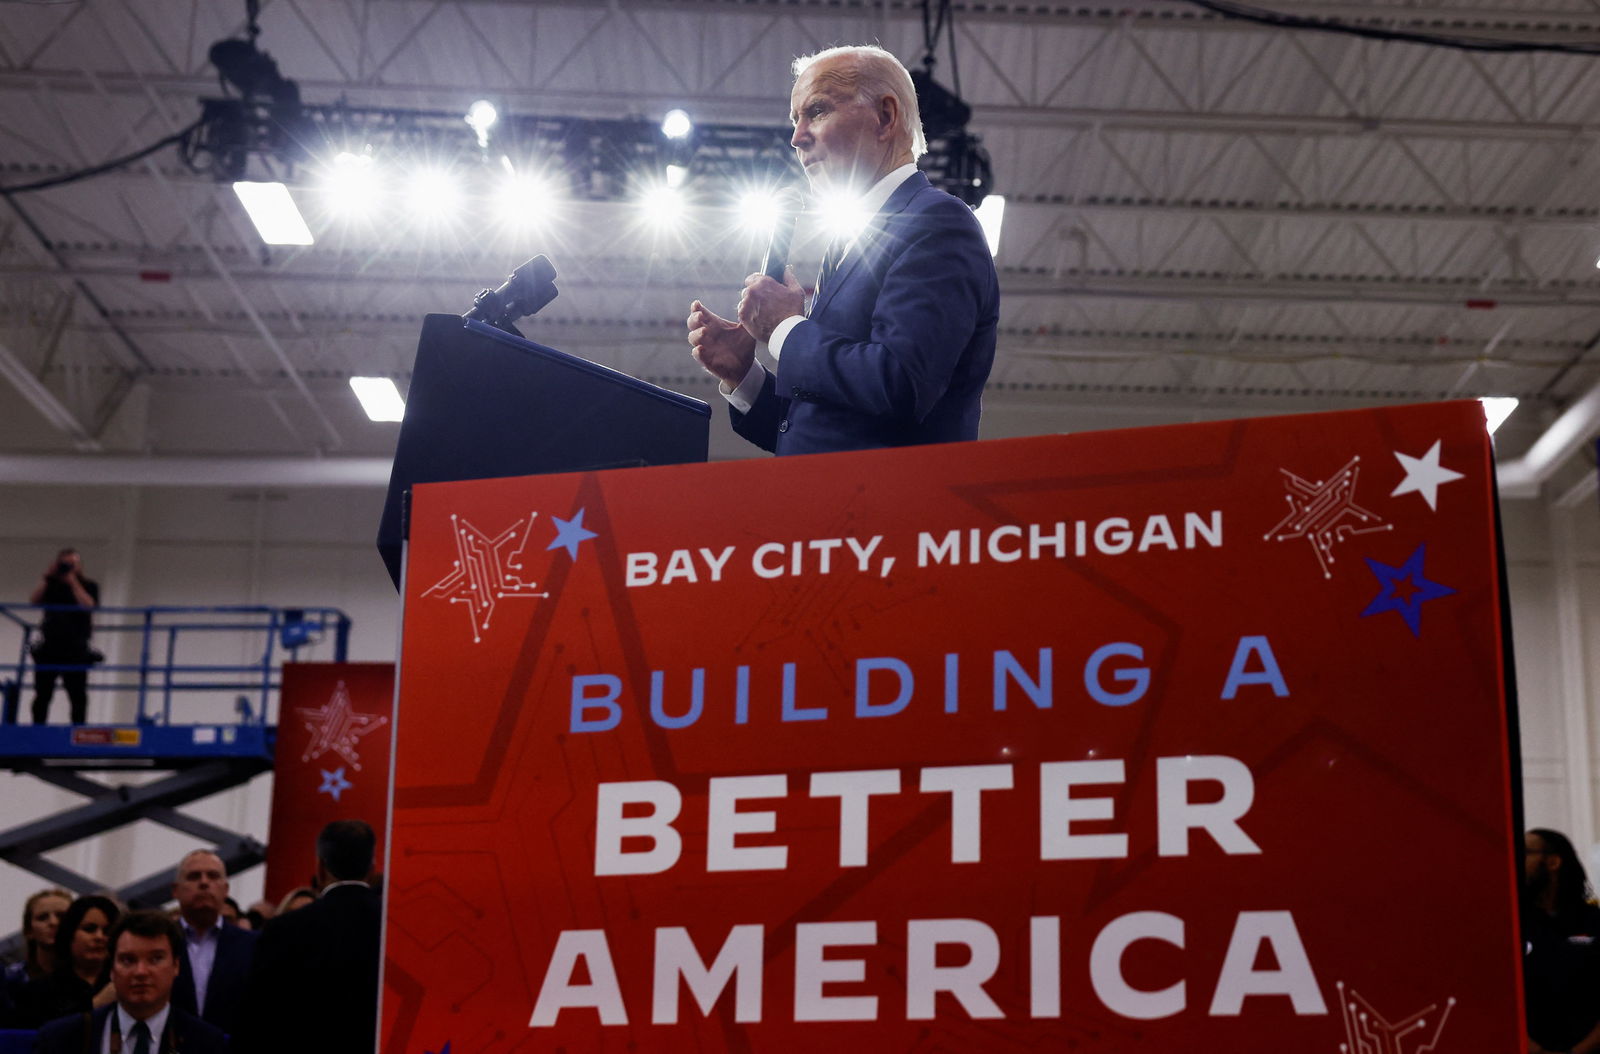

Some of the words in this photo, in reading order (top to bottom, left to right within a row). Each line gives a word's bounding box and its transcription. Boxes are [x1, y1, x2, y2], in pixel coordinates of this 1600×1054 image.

[625, 545, 736, 588] BAY
[751, 535, 896, 579] CITY,
[917, 510, 1223, 568] MICHIGAN
[570, 642, 1151, 733] BUILDING
[1221, 635, 1289, 699] A
[594, 756, 1262, 876] BETTER
[528, 910, 1328, 1027] AMERICA
